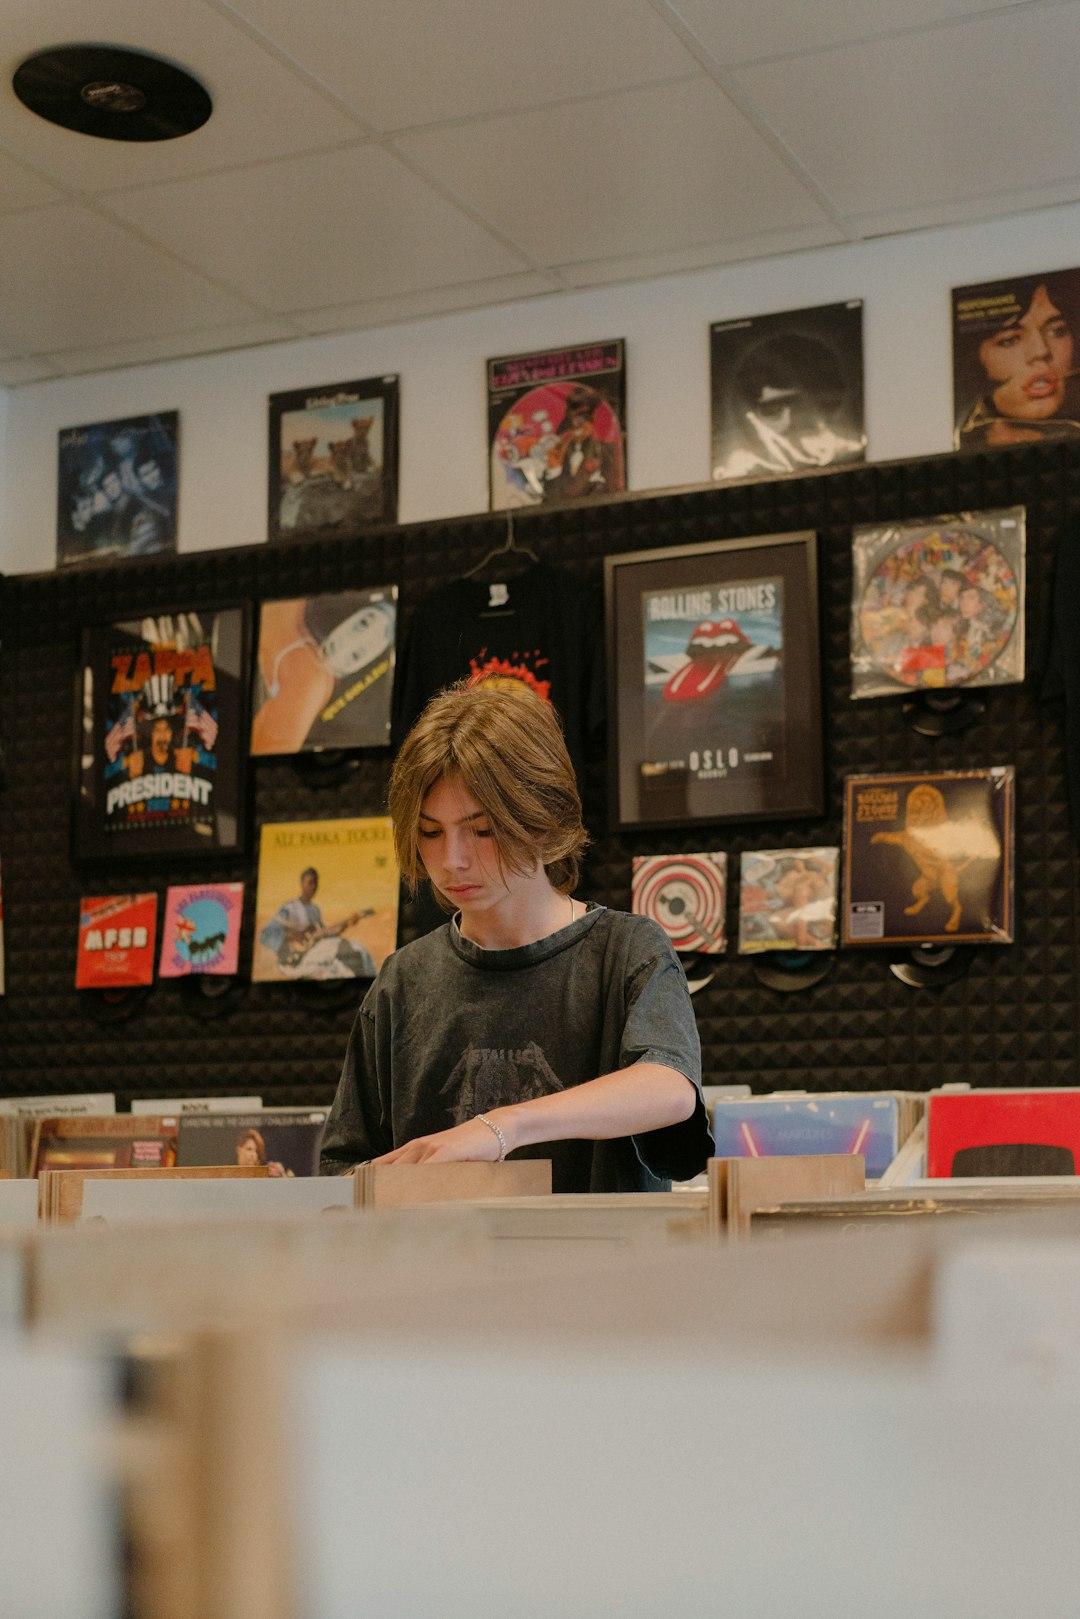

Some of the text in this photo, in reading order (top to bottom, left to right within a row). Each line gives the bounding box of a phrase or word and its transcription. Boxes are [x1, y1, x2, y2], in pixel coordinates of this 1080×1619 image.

[649, 584, 776, 620] ROLLING STONES
[106, 772, 213, 815] PRESIDENT
